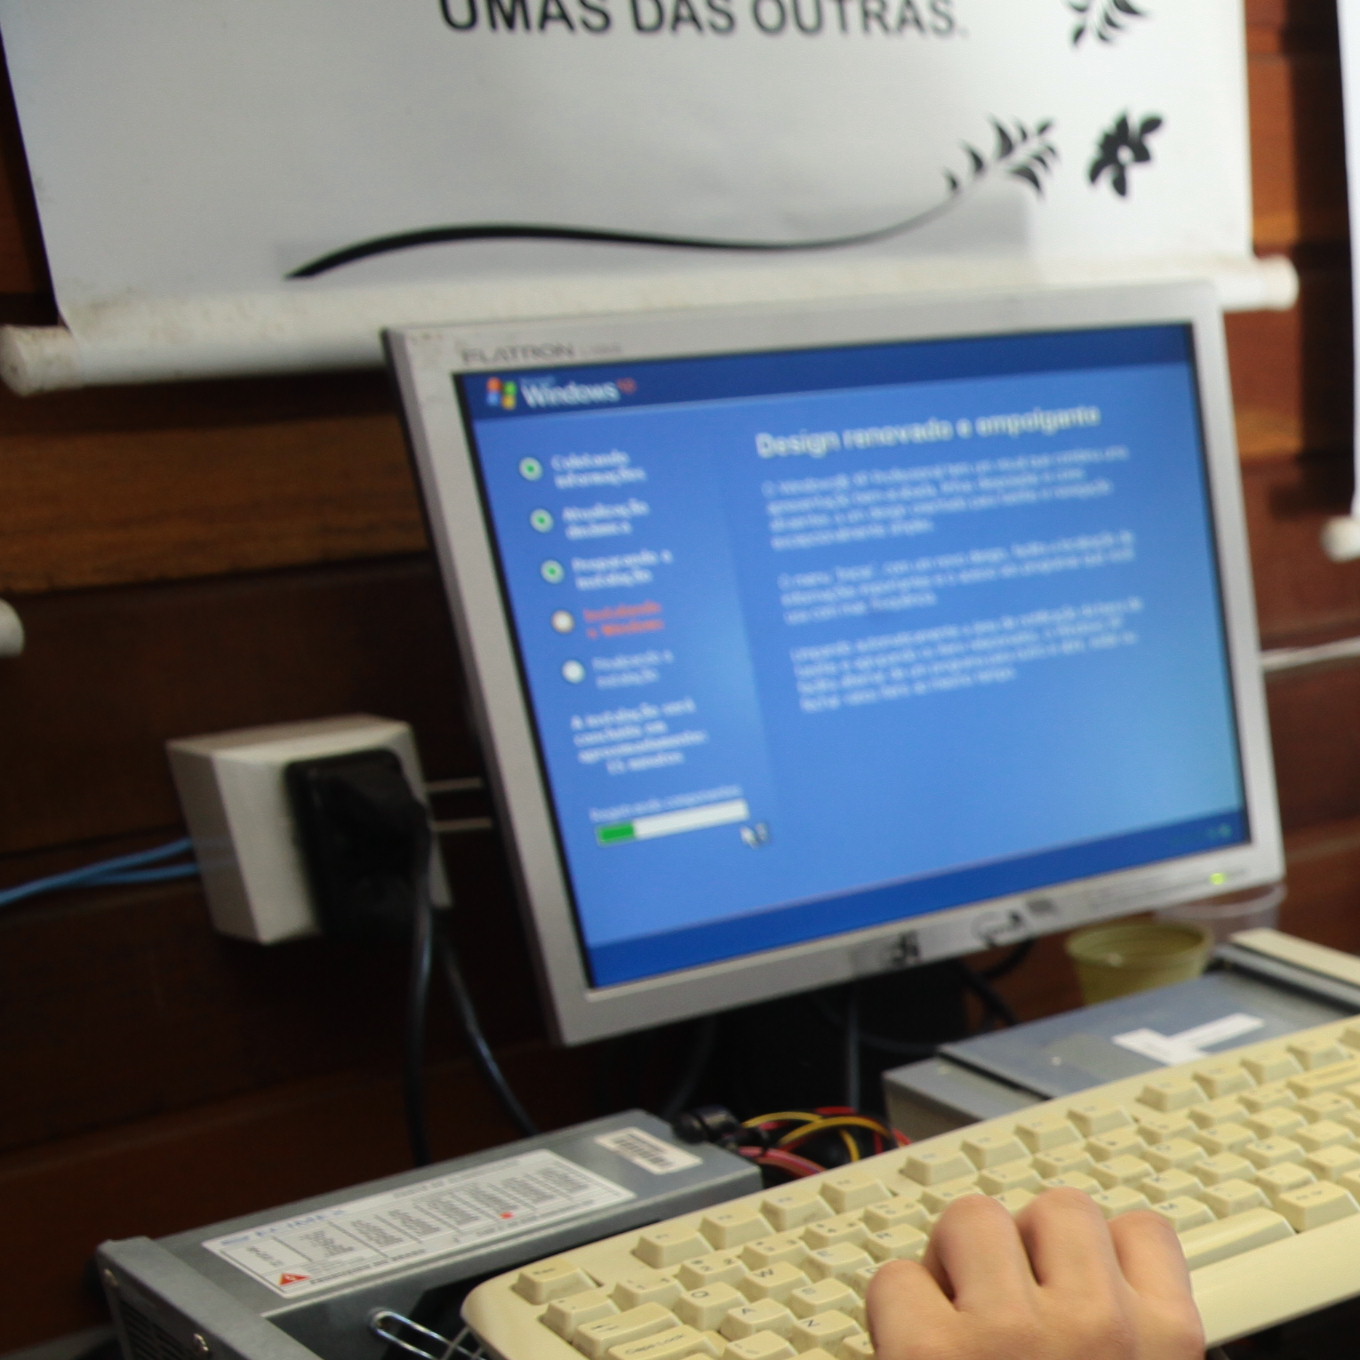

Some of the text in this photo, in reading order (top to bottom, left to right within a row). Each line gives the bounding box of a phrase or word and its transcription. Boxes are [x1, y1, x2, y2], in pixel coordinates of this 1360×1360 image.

[632, 0, 735, 36] DAS
[462, 344, 575, 366] FLATRON
[521, 381, 621, 409] Windows
[756, 430, 841, 459] Design
[842, 416, 954, 450] renovado
